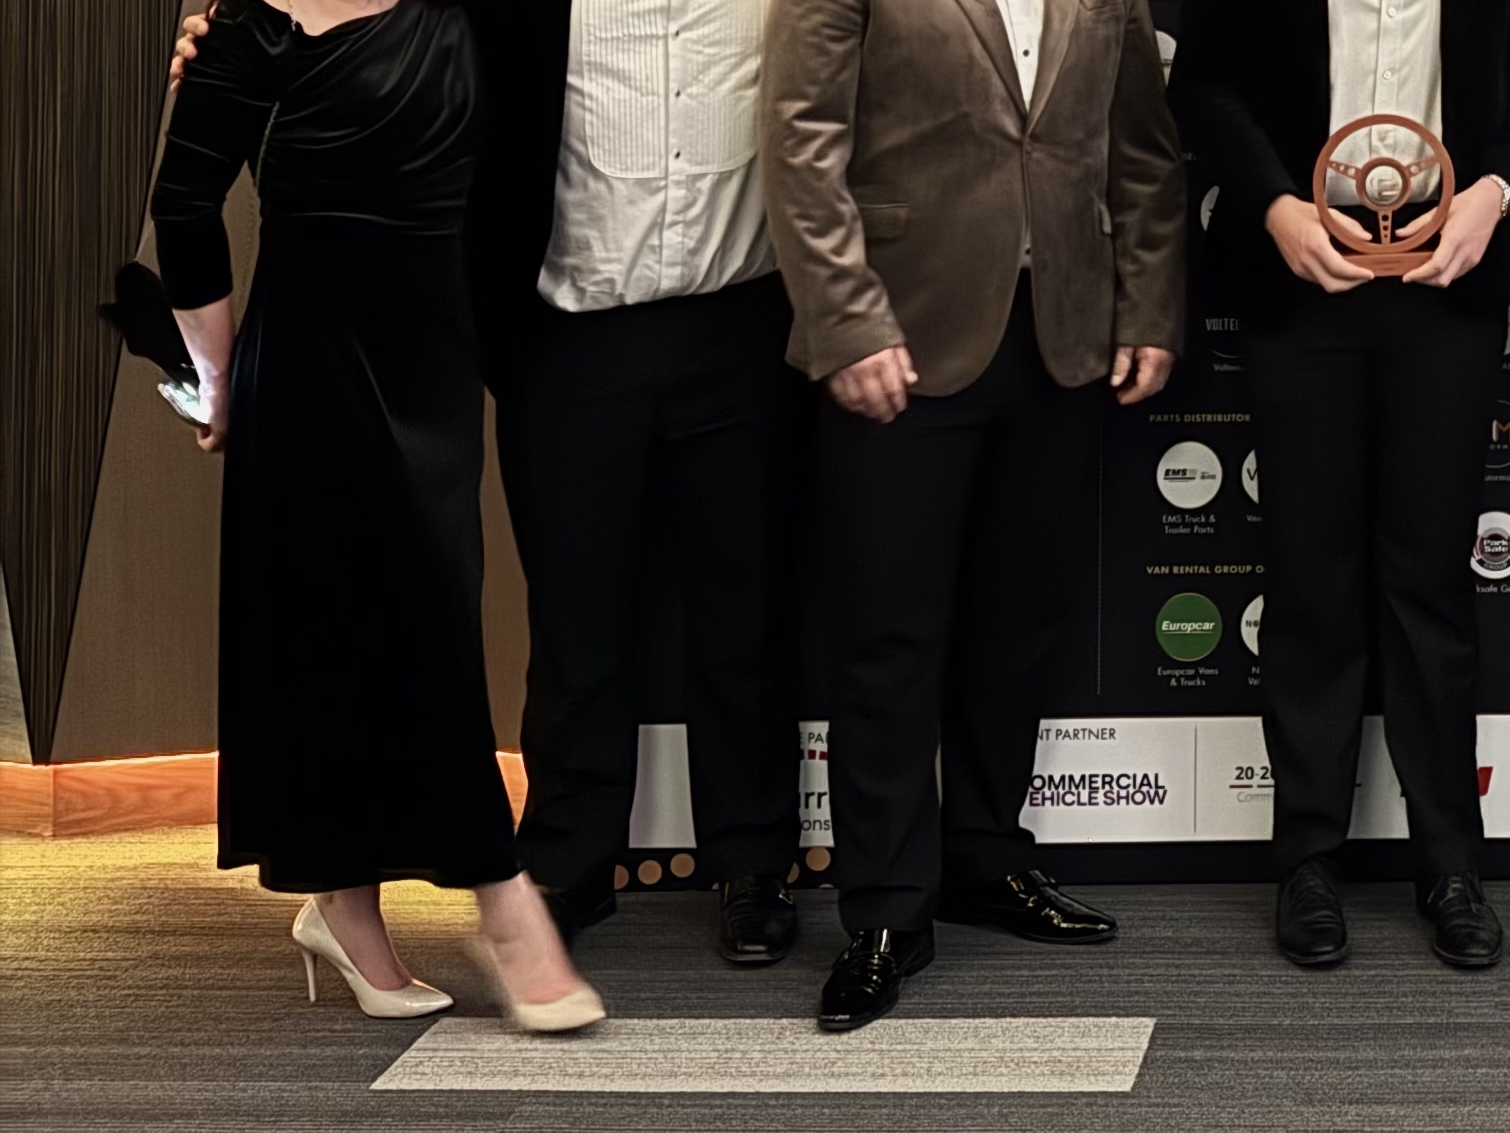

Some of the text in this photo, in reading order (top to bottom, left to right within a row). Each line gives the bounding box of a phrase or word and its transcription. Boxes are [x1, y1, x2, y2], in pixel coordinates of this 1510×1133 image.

[1150, 413, 1180, 422] PARTS
[1184, 514, 1206, 523] Truck
[1146, 565, 1169, 574] VAN
[1172, 565, 1211, 574] RENTAL
[1214, 565, 1252, 574] GROUP
[1161, 620, 1215, 633] Europcar
[1157, 667, 1195, 677] Europcar
[1180, 677, 1206, 686] Trucks
[1056, 728, 1116, 740] PARTNER
[1103, 790, 1167, 806] SHOW
